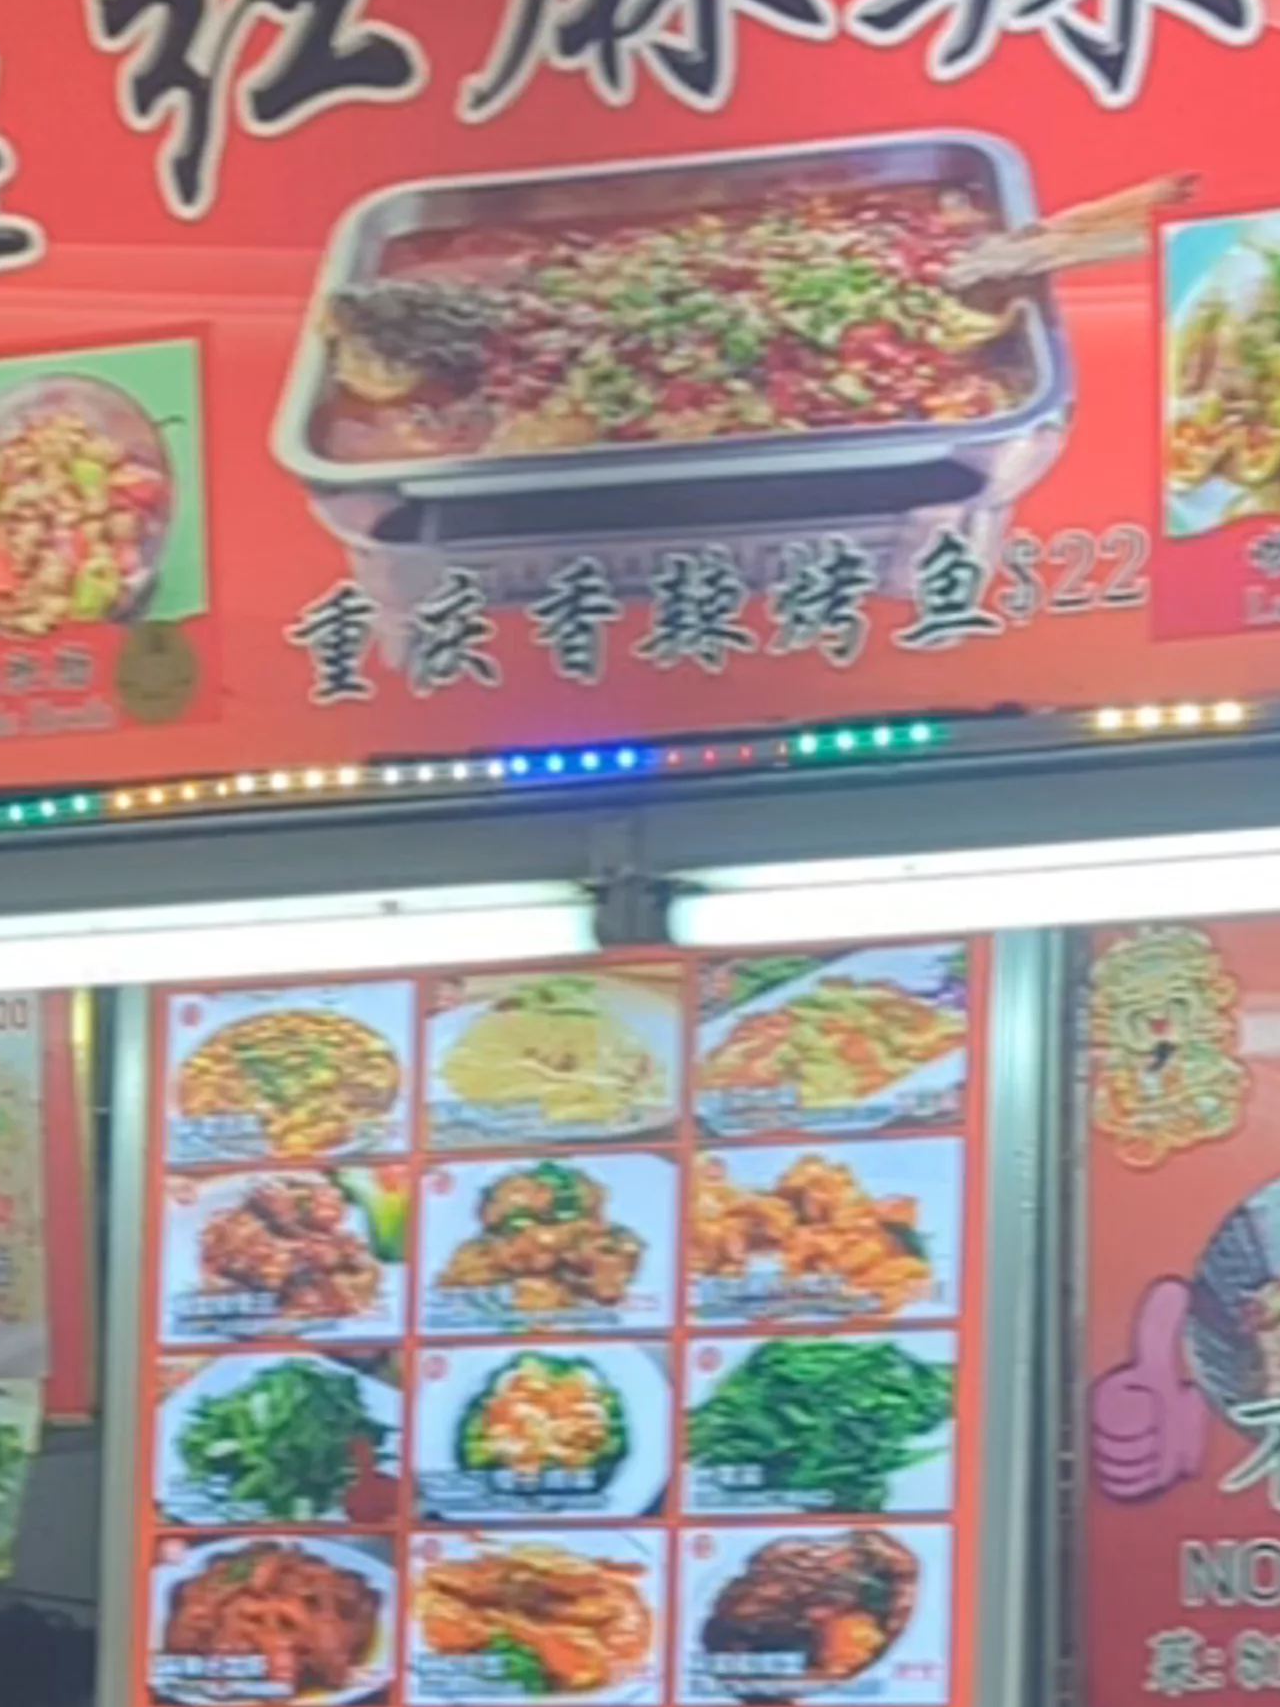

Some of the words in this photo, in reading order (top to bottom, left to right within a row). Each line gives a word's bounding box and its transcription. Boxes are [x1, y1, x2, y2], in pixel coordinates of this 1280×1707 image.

[282, 527, 1004, 707] 重庆香辣烤鱼
[996, 521, 1152, 625] $22
